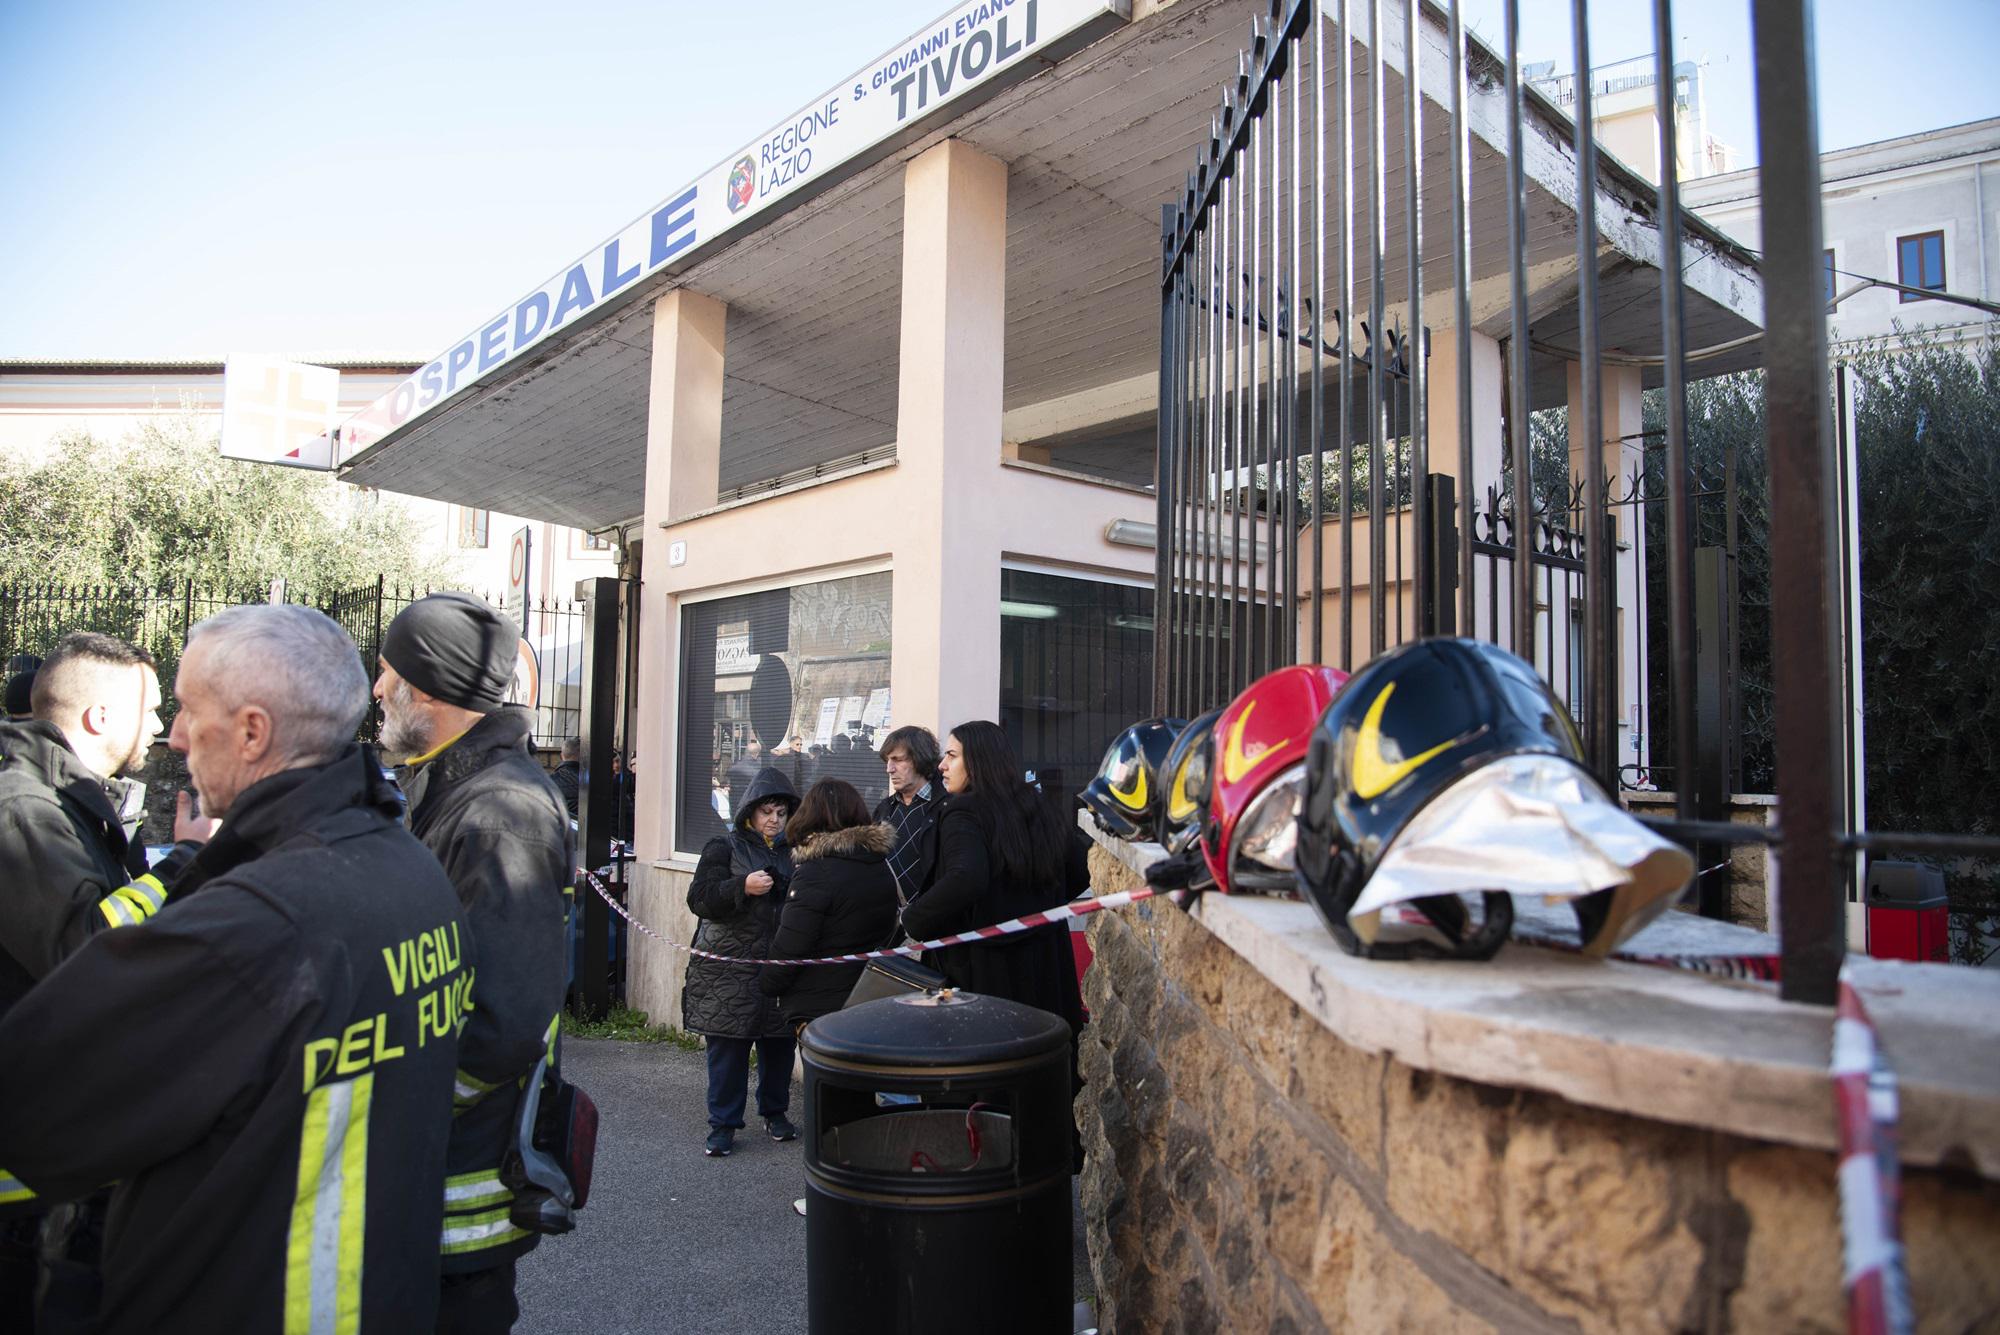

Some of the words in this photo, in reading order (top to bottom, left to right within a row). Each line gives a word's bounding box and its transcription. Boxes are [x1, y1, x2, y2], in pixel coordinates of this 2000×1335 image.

[853, 84, 867, 101] S.
[871, 32, 949, 89] GIOVANNI
[890, 0, 1038, 122] TIVOLI
[761, 97, 839, 168] REGIONE
[760, 147, 812, 198] LAZIO
[388, 185, 698, 426] OSPEDALE
[382, 921, 461, 996] VIGILI
[303, 1013, 405, 1095] DEL
[418, 966, 476, 1048] FUOC
